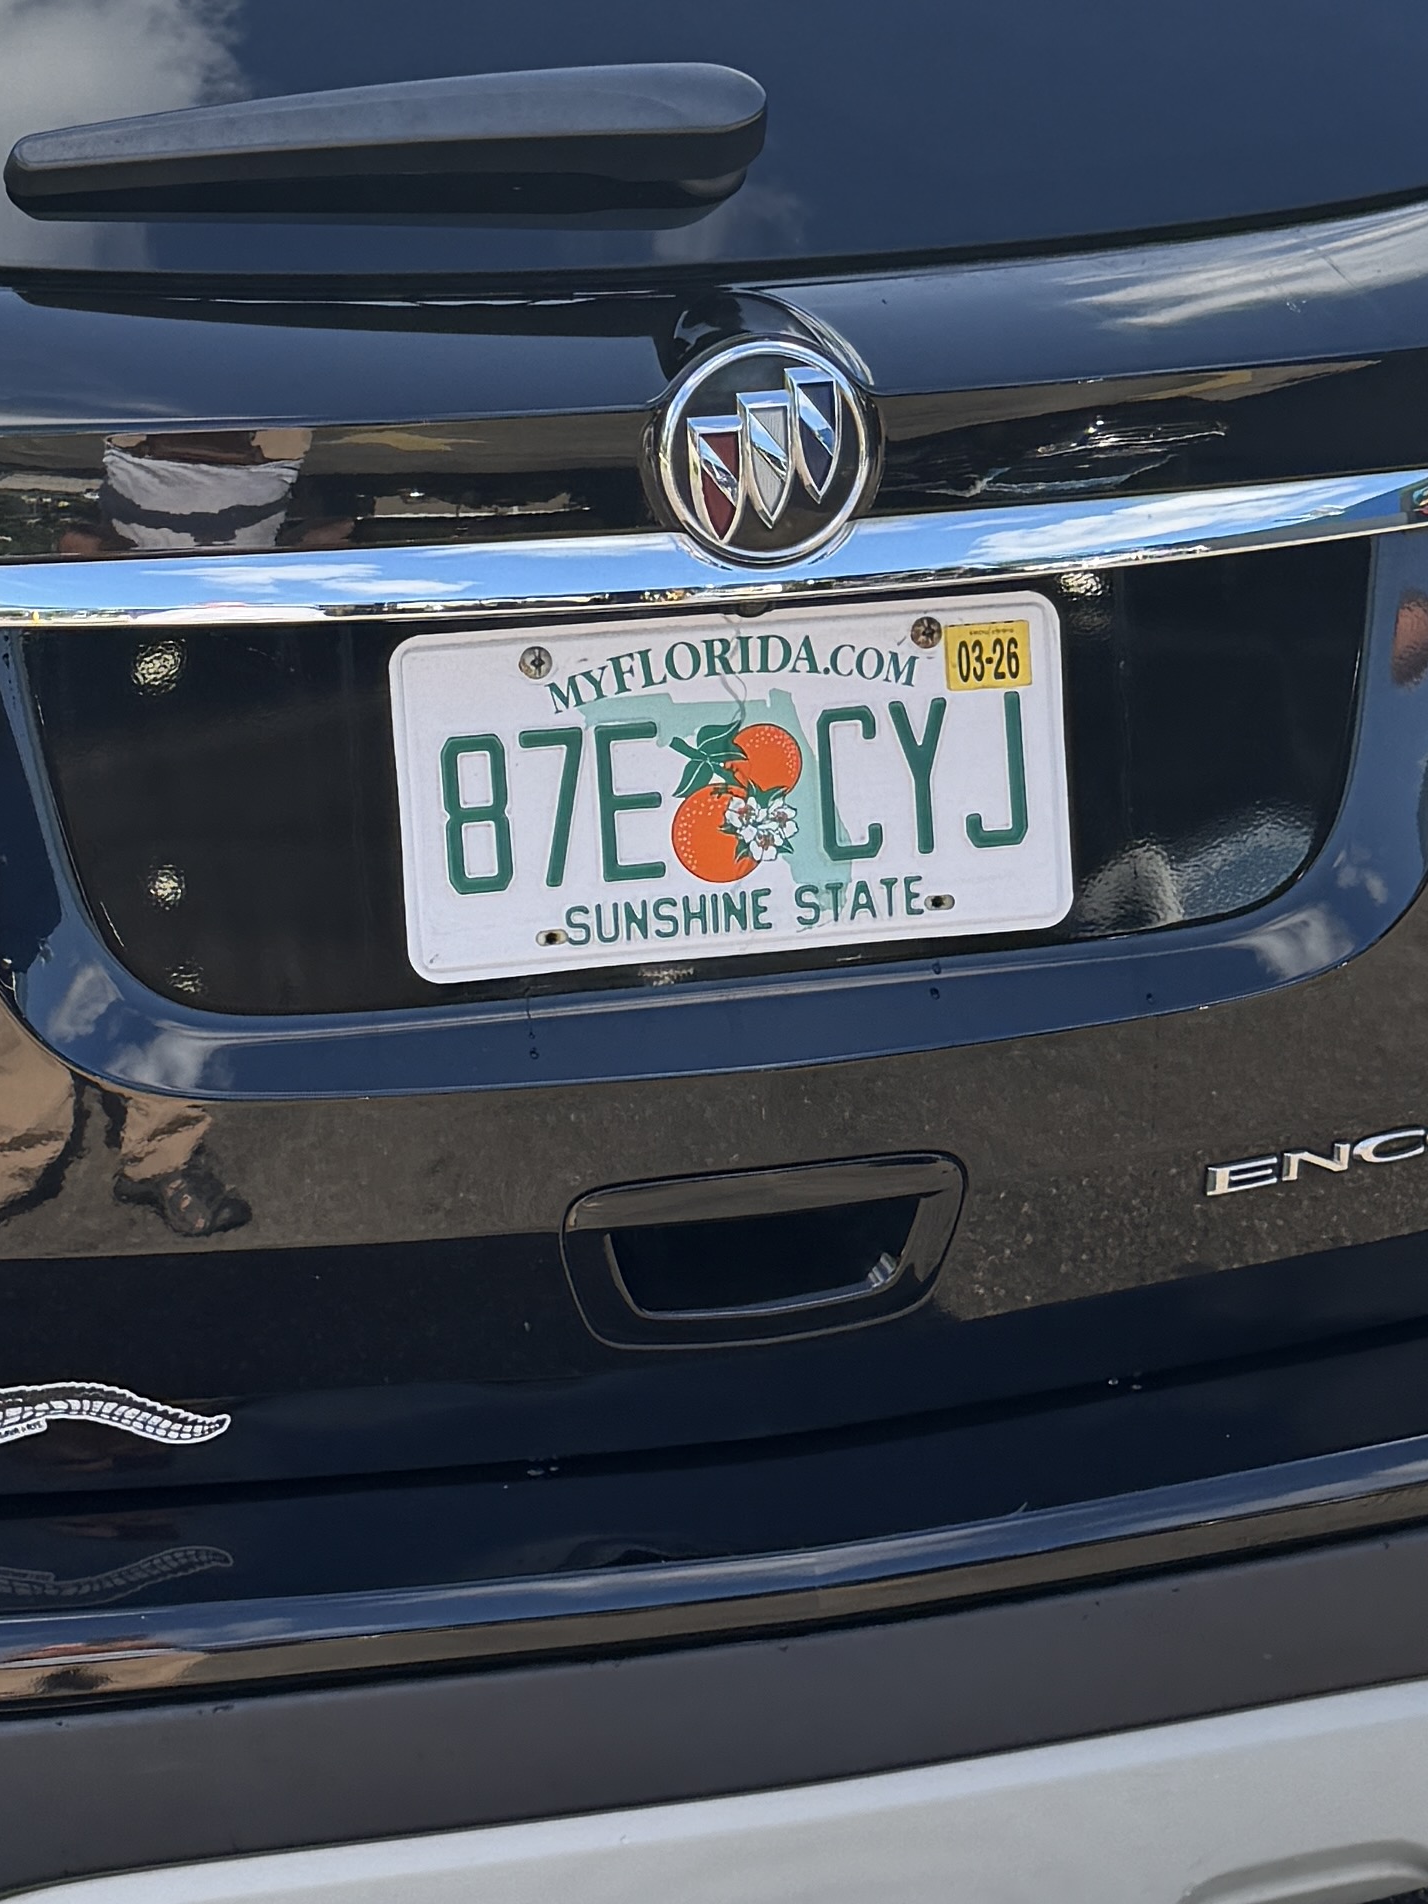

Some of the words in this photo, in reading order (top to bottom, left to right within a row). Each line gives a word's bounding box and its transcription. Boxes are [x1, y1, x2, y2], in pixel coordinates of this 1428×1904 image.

[544, 633, 919, 715] MYFLORIDA.COM
[957, 636, 1020, 683] 03-26
[440, 721, 667, 895] 87E
[816, 691, 1029, 862] CYJ
[564, 887, 773, 947] SUNSHINE
[795, 875, 925, 927] STATE
